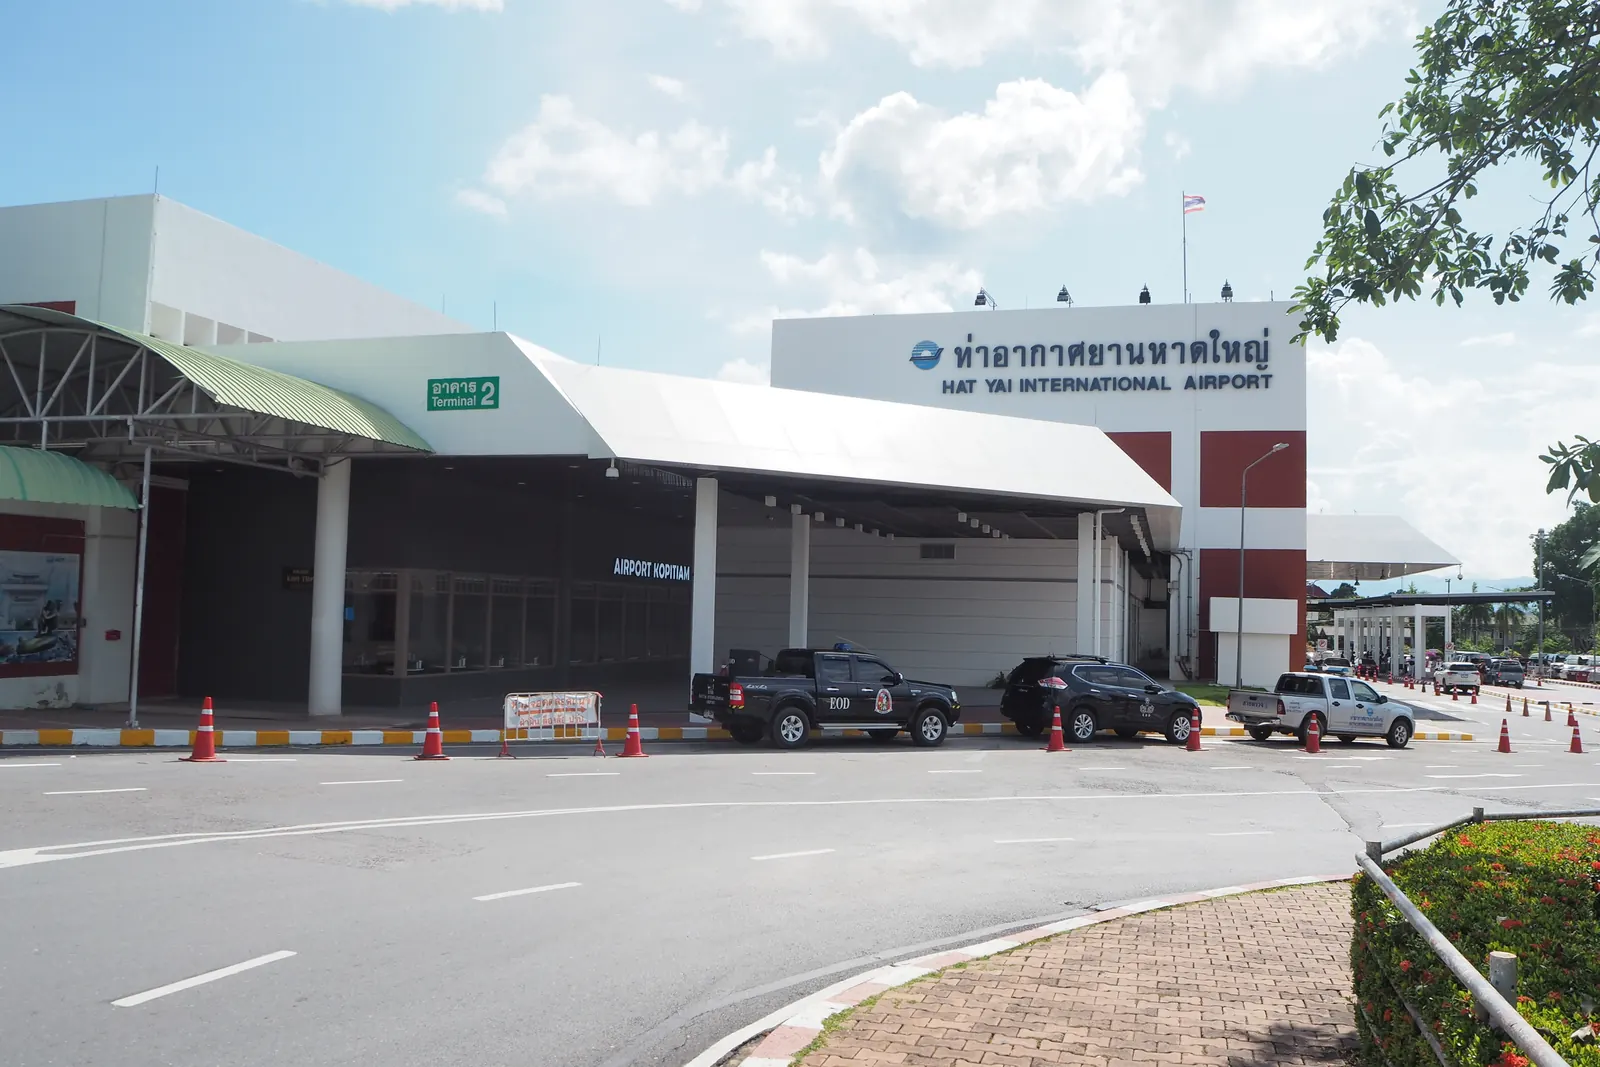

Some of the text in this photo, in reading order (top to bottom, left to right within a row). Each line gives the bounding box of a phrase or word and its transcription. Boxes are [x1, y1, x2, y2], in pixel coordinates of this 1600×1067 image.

[953, 327, 1269, 371] ท่าอากาศยานหาดใหญ่
[431, 381, 477, 394] อาคาร
[431, 381, 495, 408] Terminal 2
[942, 373, 1274, 394] HAT YAI INTERNATIONAL AIRPORT
[613, 557, 690, 581] AIRPORT KOPITIAM
[829, 697, 850, 710] EOD
